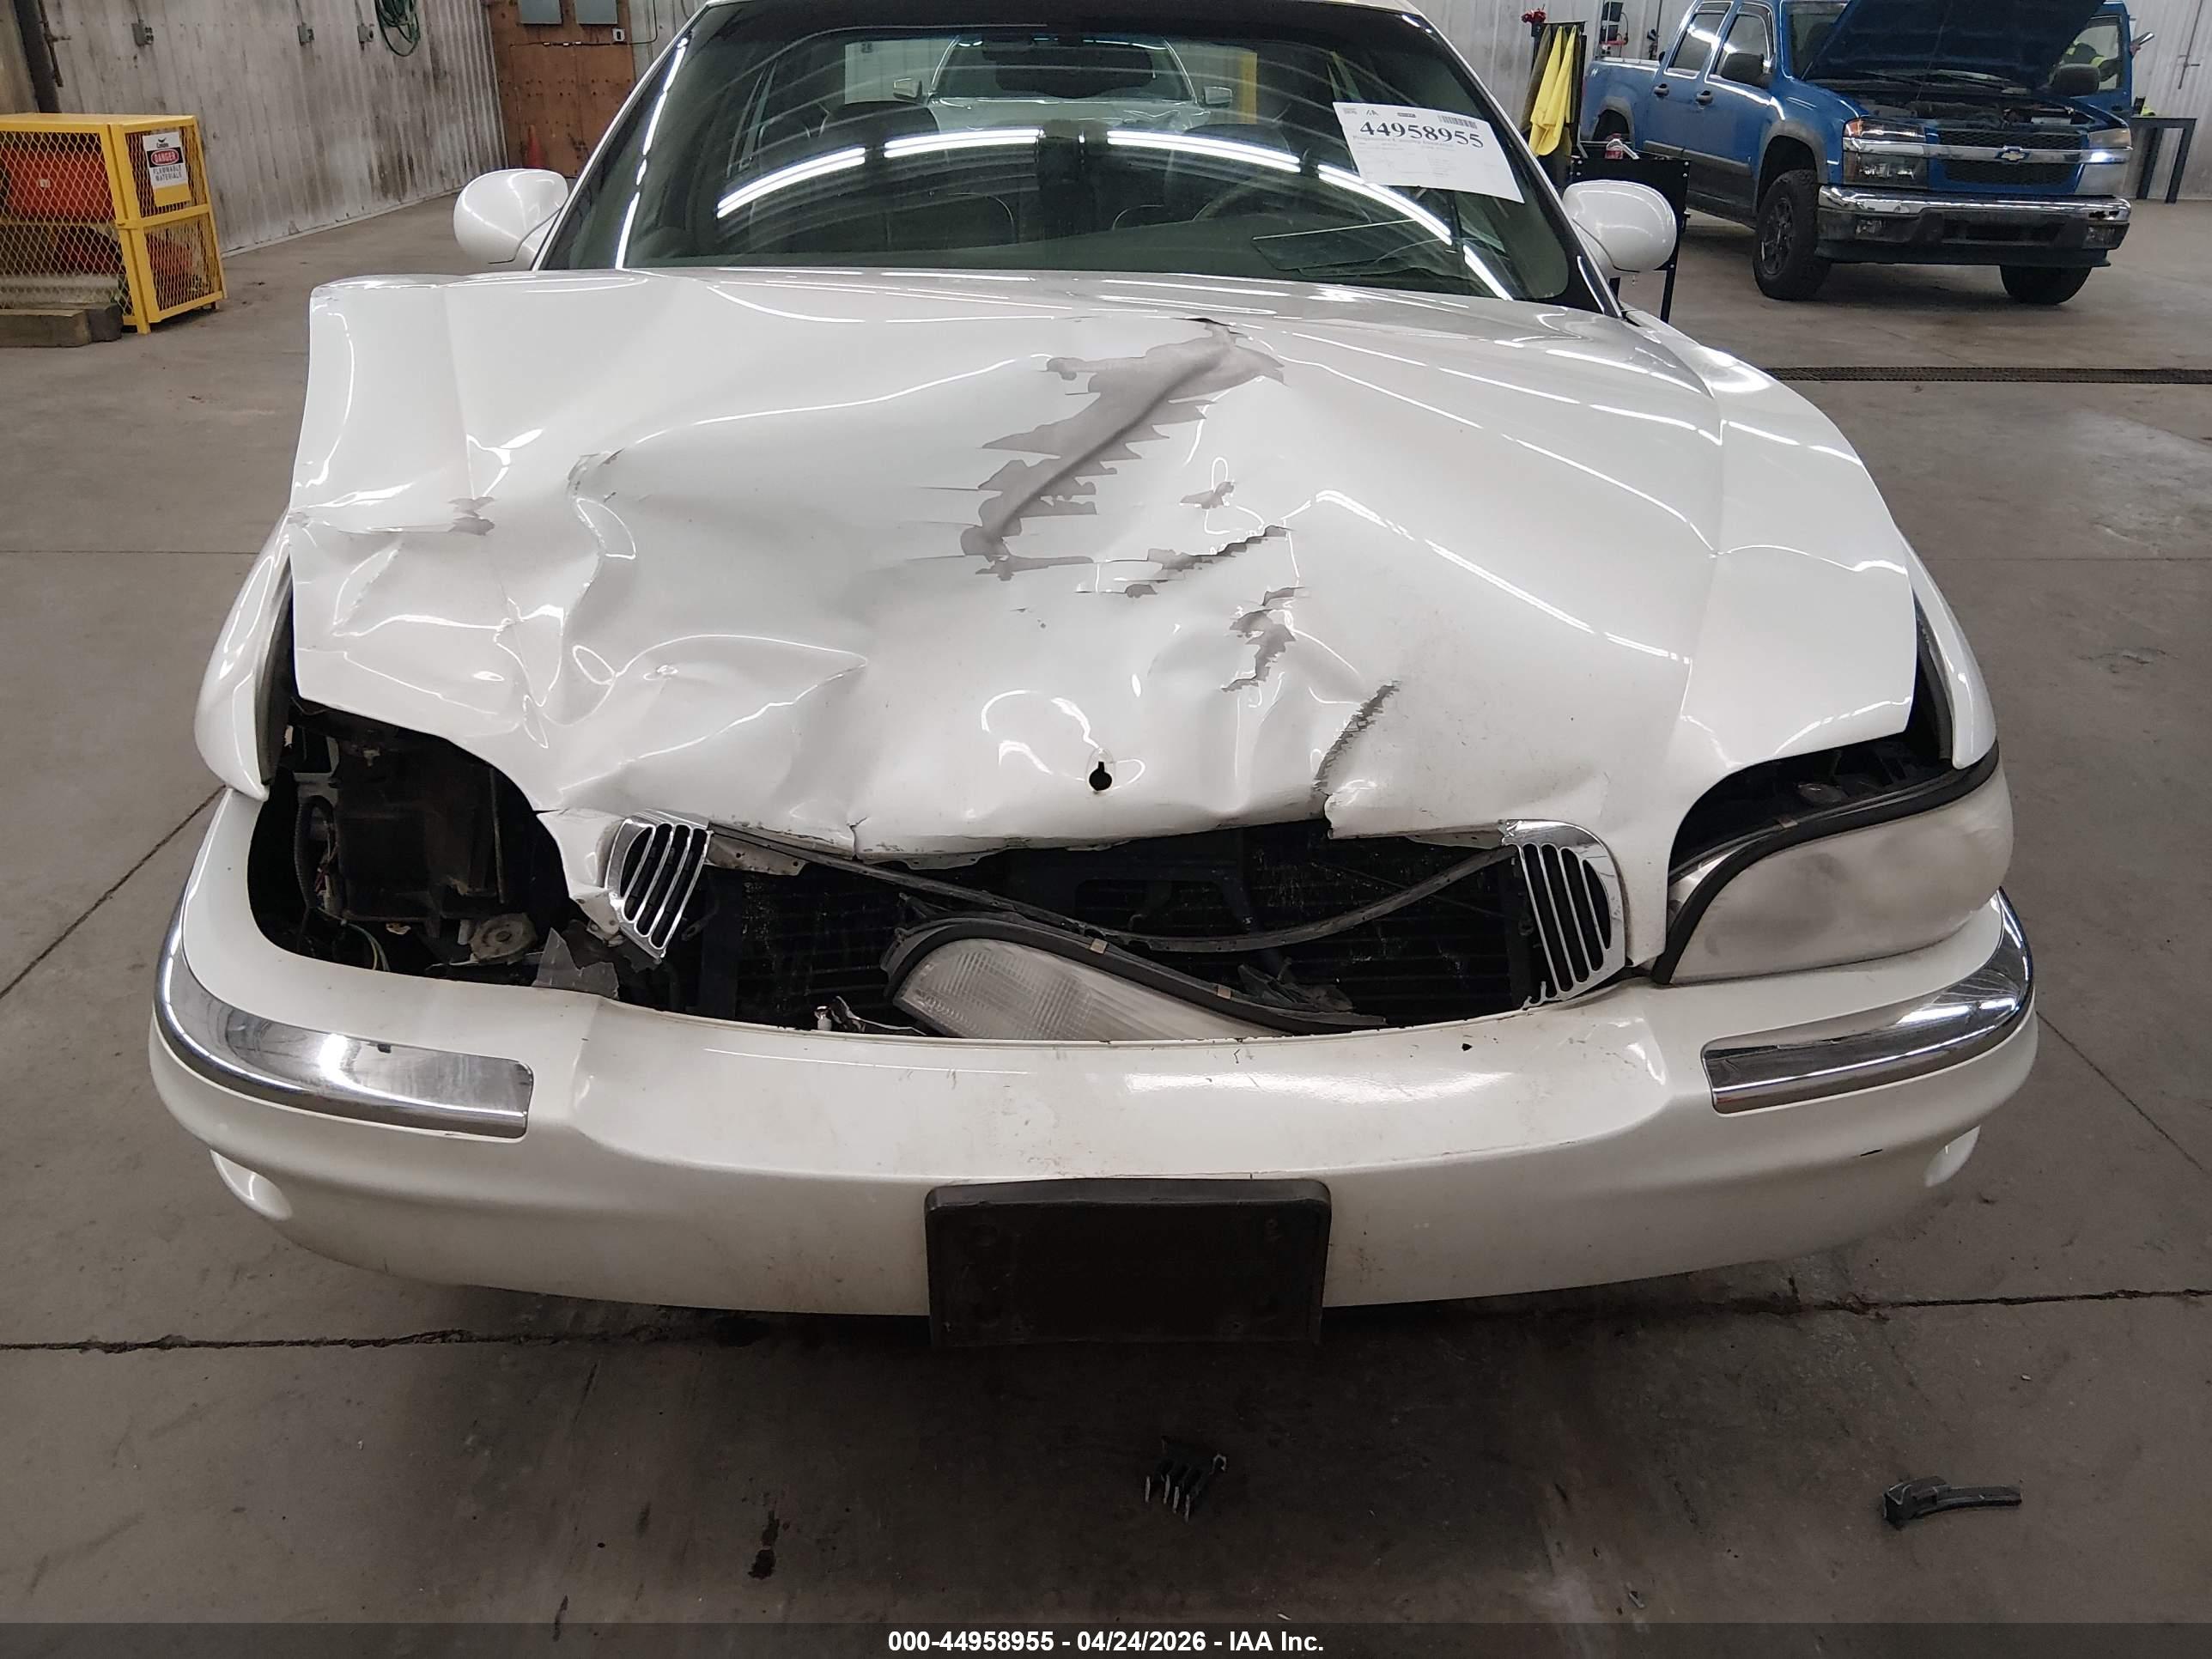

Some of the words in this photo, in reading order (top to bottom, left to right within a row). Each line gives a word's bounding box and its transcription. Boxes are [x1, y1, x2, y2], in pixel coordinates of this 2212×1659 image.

[1360, 121, 1484, 148] 44958955
[154, 151, 176, 162] DANGER
[153, 165, 181, 174] FLAMMABLE
[155, 172, 182, 181] MATERIALS
